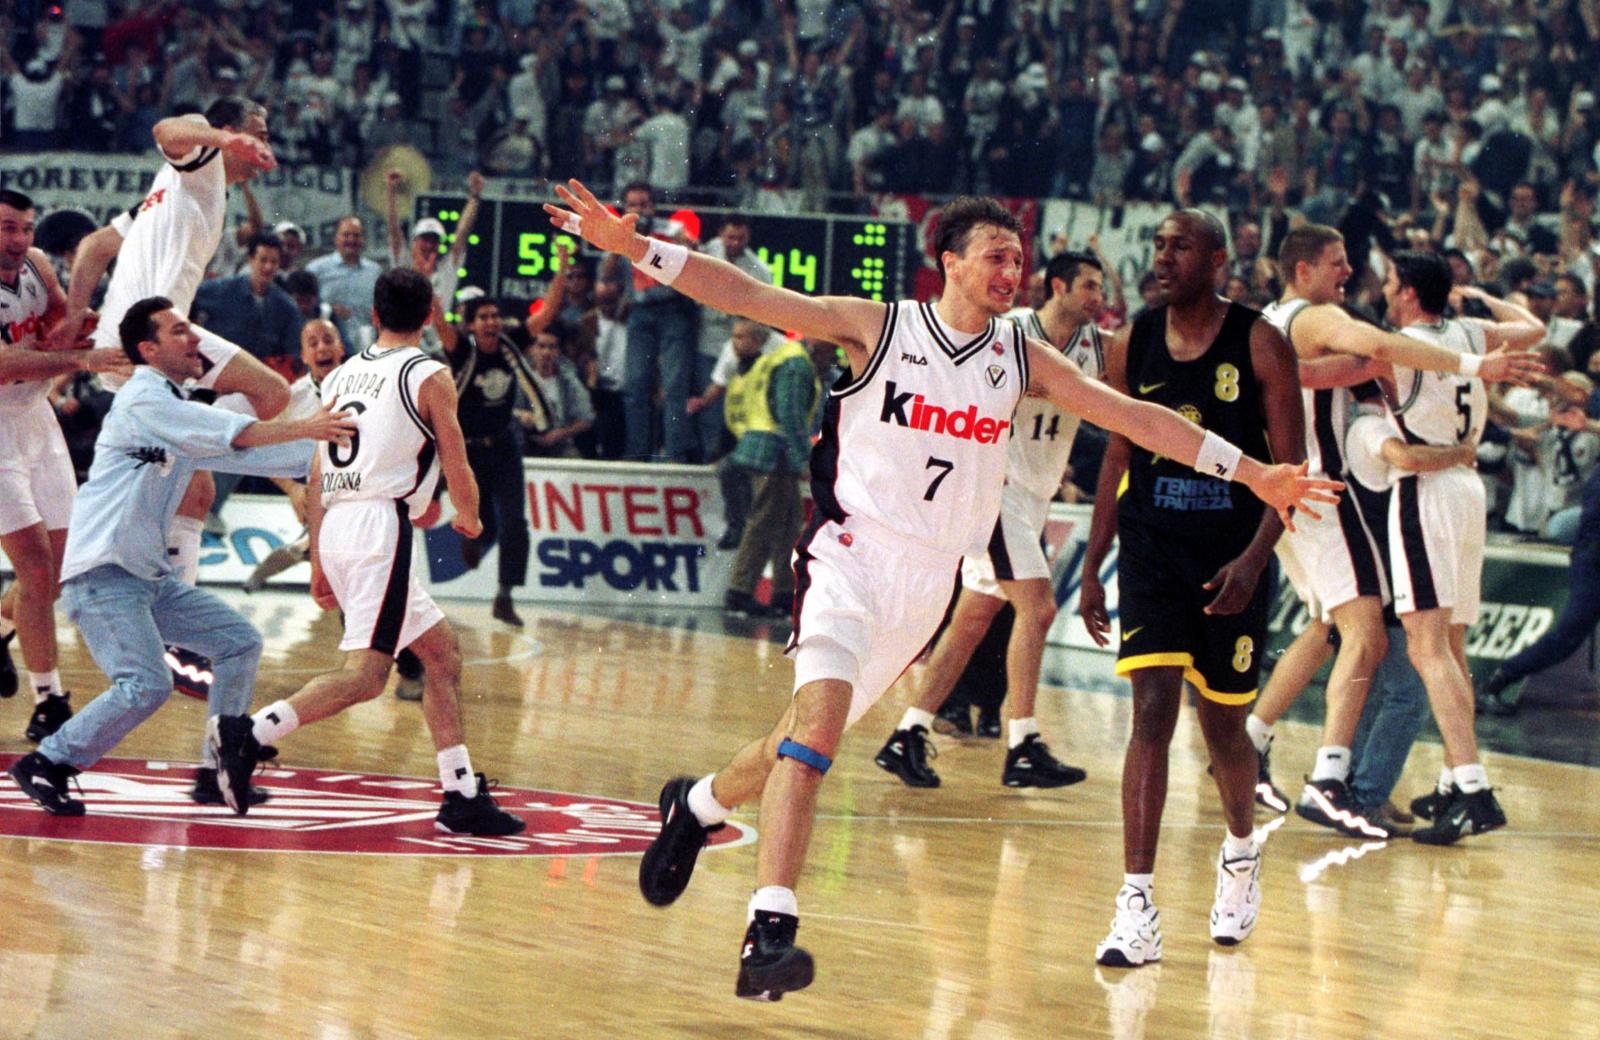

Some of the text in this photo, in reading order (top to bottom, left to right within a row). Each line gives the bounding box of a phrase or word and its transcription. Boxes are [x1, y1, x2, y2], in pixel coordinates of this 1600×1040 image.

[901, 352, 928, 366] FILA
[336, 372, 387, 399] CRIPPA
[1214, 362, 1240, 403] 8
[880, 380, 1010, 444] Kinder
[1030, 413, 1061, 441] 14
[1456, 381, 1472, 441] 5
[923, 456, 954, 501] 7
[527, 481, 705, 538] INTER
[537, 538, 706, 593] SPORT
[1231, 634, 1254, 673] 8
